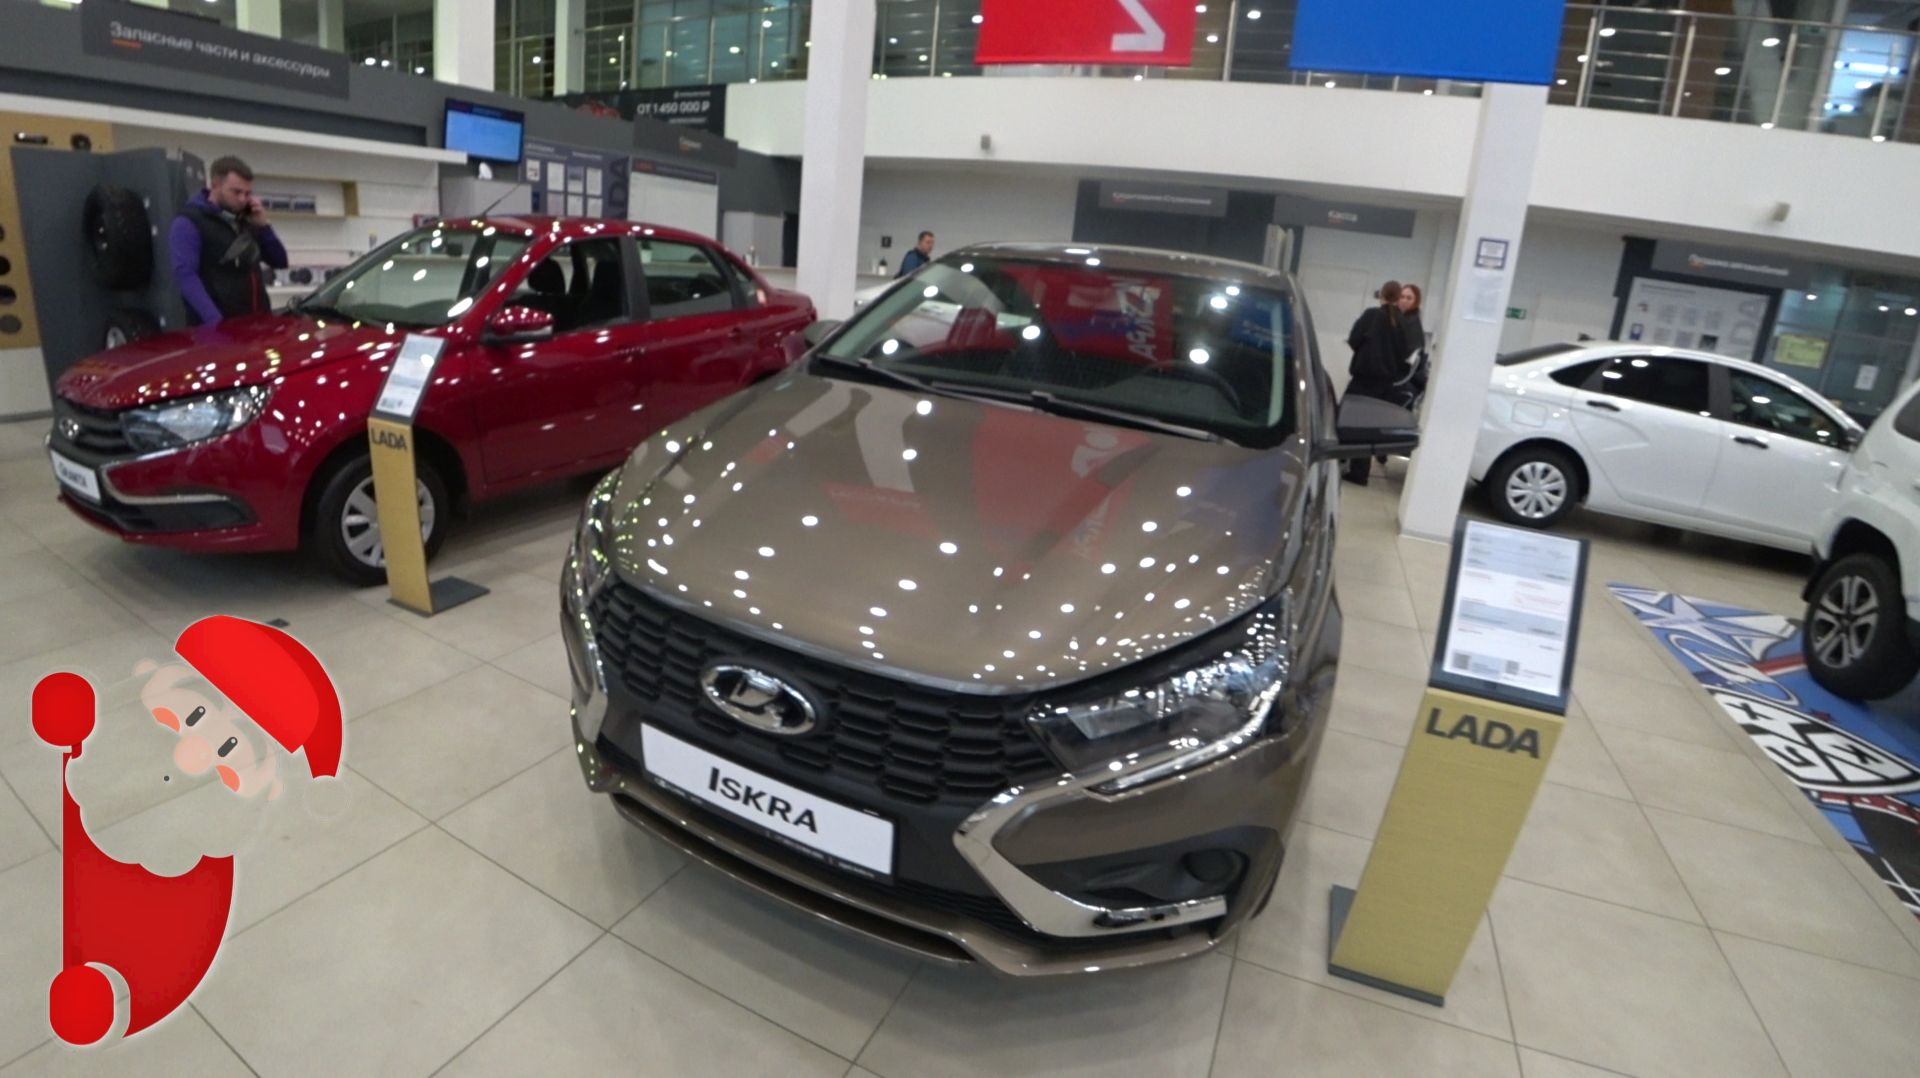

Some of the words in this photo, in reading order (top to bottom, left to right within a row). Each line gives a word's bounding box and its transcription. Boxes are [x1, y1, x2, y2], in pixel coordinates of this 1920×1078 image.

[110, 21, 193, 50] Запасные
[195, 41, 238, 58] части
[240, 49, 250, 62] и
[252, 54, 330, 78] аксессуары
[637, 102, 651, 115] ОТ
[659, 101, 678, 114] 450
[679, 100, 700, 114] 000
[371, 426, 408, 452] LADA
[1425, 707, 1541, 758] LADA
[708, 766, 818, 834] ISKRA
